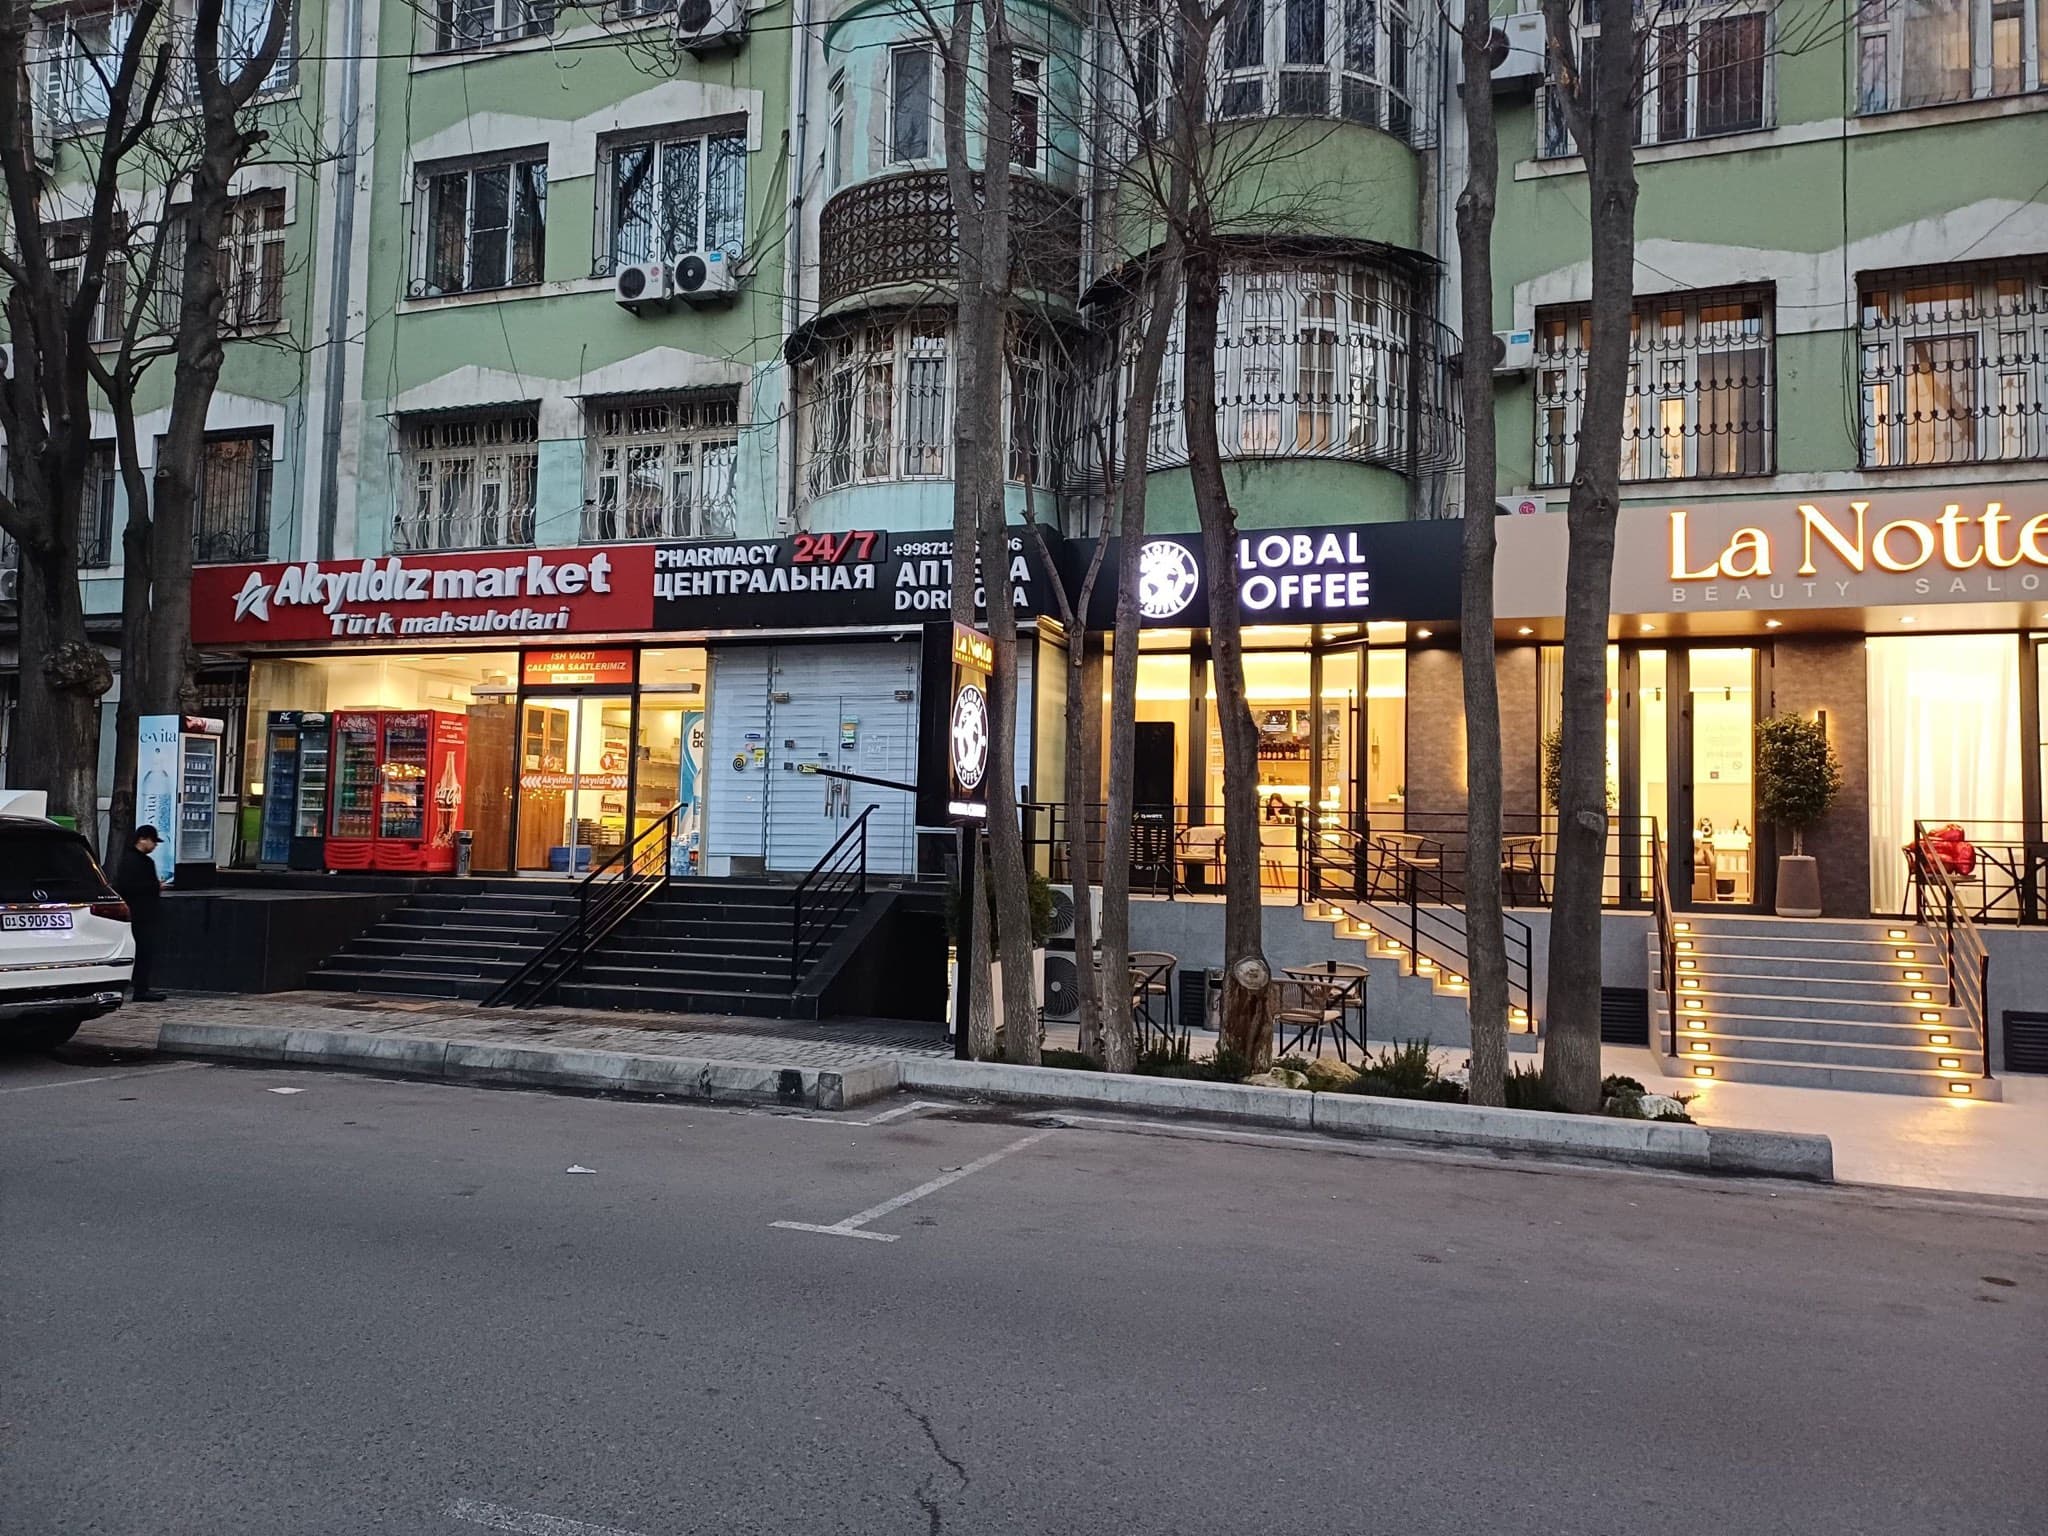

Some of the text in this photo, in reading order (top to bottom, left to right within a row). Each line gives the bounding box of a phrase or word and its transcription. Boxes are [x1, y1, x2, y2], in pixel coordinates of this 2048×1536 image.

[654, 544, 777, 568] PHARMACY
[793, 530, 877, 563] 24/7
[1236, 532, 1366, 569] LOBAL
[1670, 502, 2048, 579] La Notte
[433, 552, 612, 600] market
[653, 563, 876, 601] ЦЕНТРАЛЬНАЯ
[1241, 572, 1370, 610] OFFEE
[1672, 581, 1850, 602] BEAUTY
[329, 606, 571, 636] Türk mahsulotlari
[5, 917, 16, 927] 01
[50, 915, 66, 927] SS
